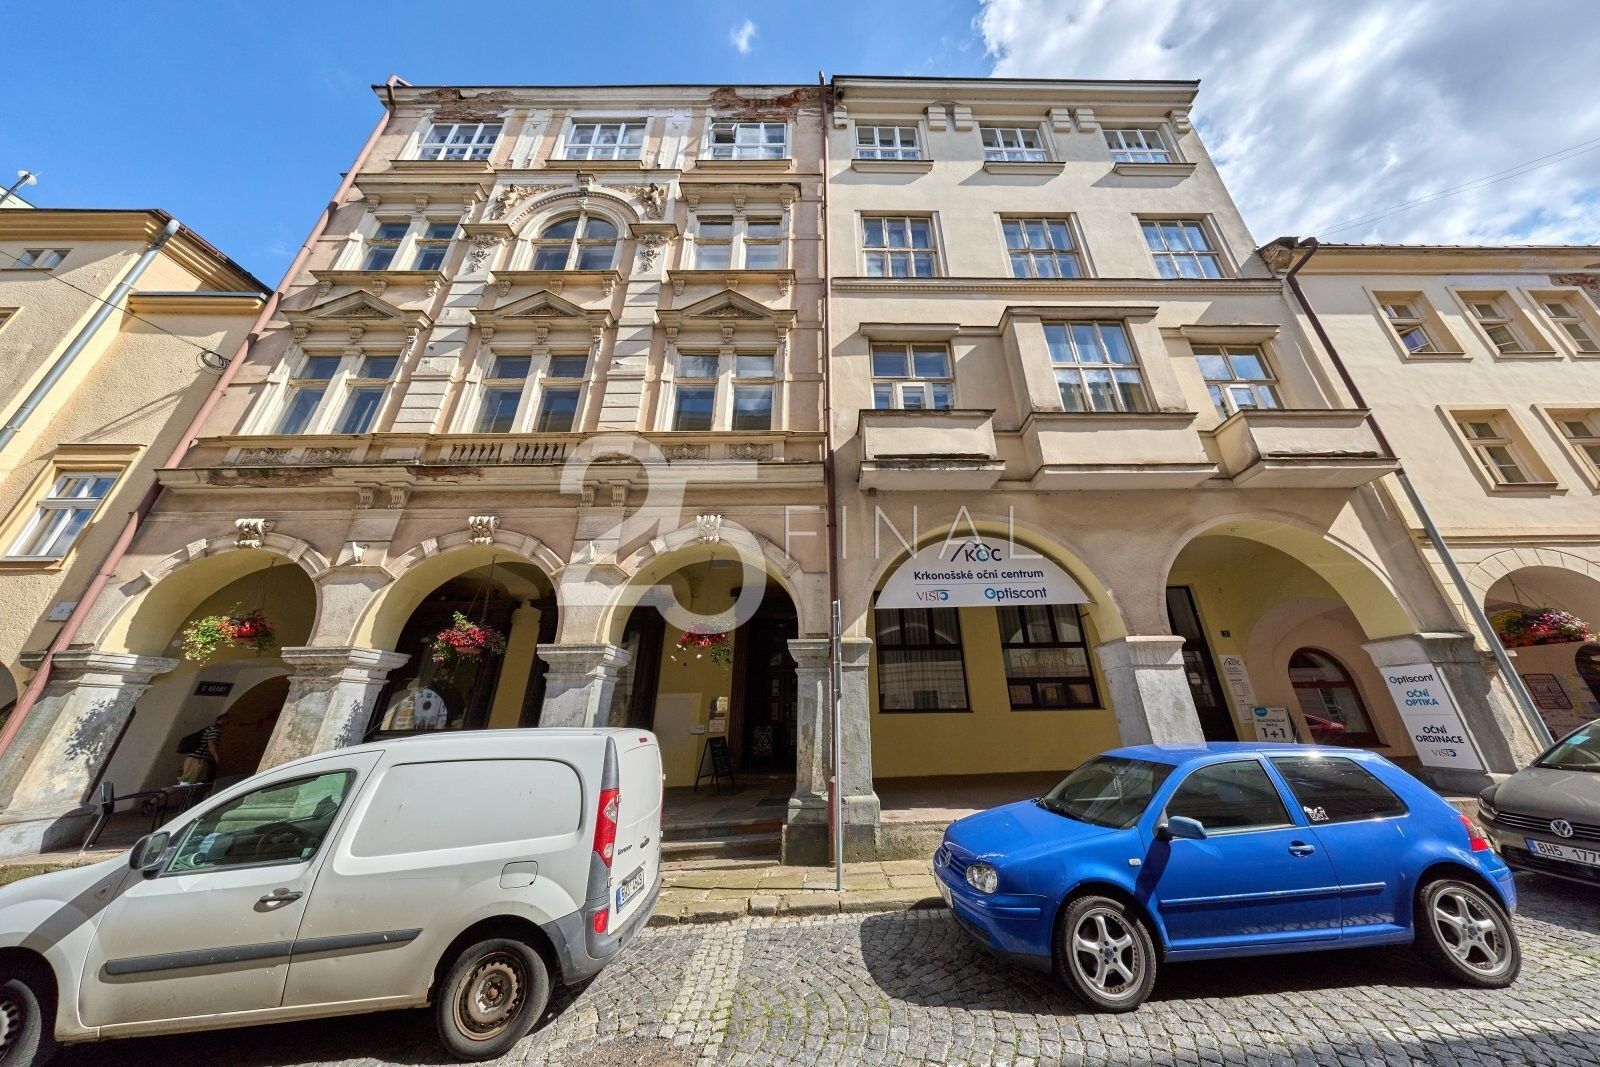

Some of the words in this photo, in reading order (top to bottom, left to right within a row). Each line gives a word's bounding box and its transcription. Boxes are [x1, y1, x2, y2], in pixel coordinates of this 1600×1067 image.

[914, 569, 974, 581] Krkonošské
[977, 569, 998, 580] oční
[1001, 570, 1044, 580] centrum
[984, 587, 1047, 602] Optiscont
[1389, 673, 1434, 685] Optiscont
[1406, 689, 1430, 698] OČNÍ
[1405, 699, 1440, 707] OPTIKA
[1261, 727, 1286, 739] 1+1
[1423, 724, 1448, 734] OČNÍ
[1415, 735, 1465, 744] ORDINACE
[1537, 842, 1563, 857] 8H5
